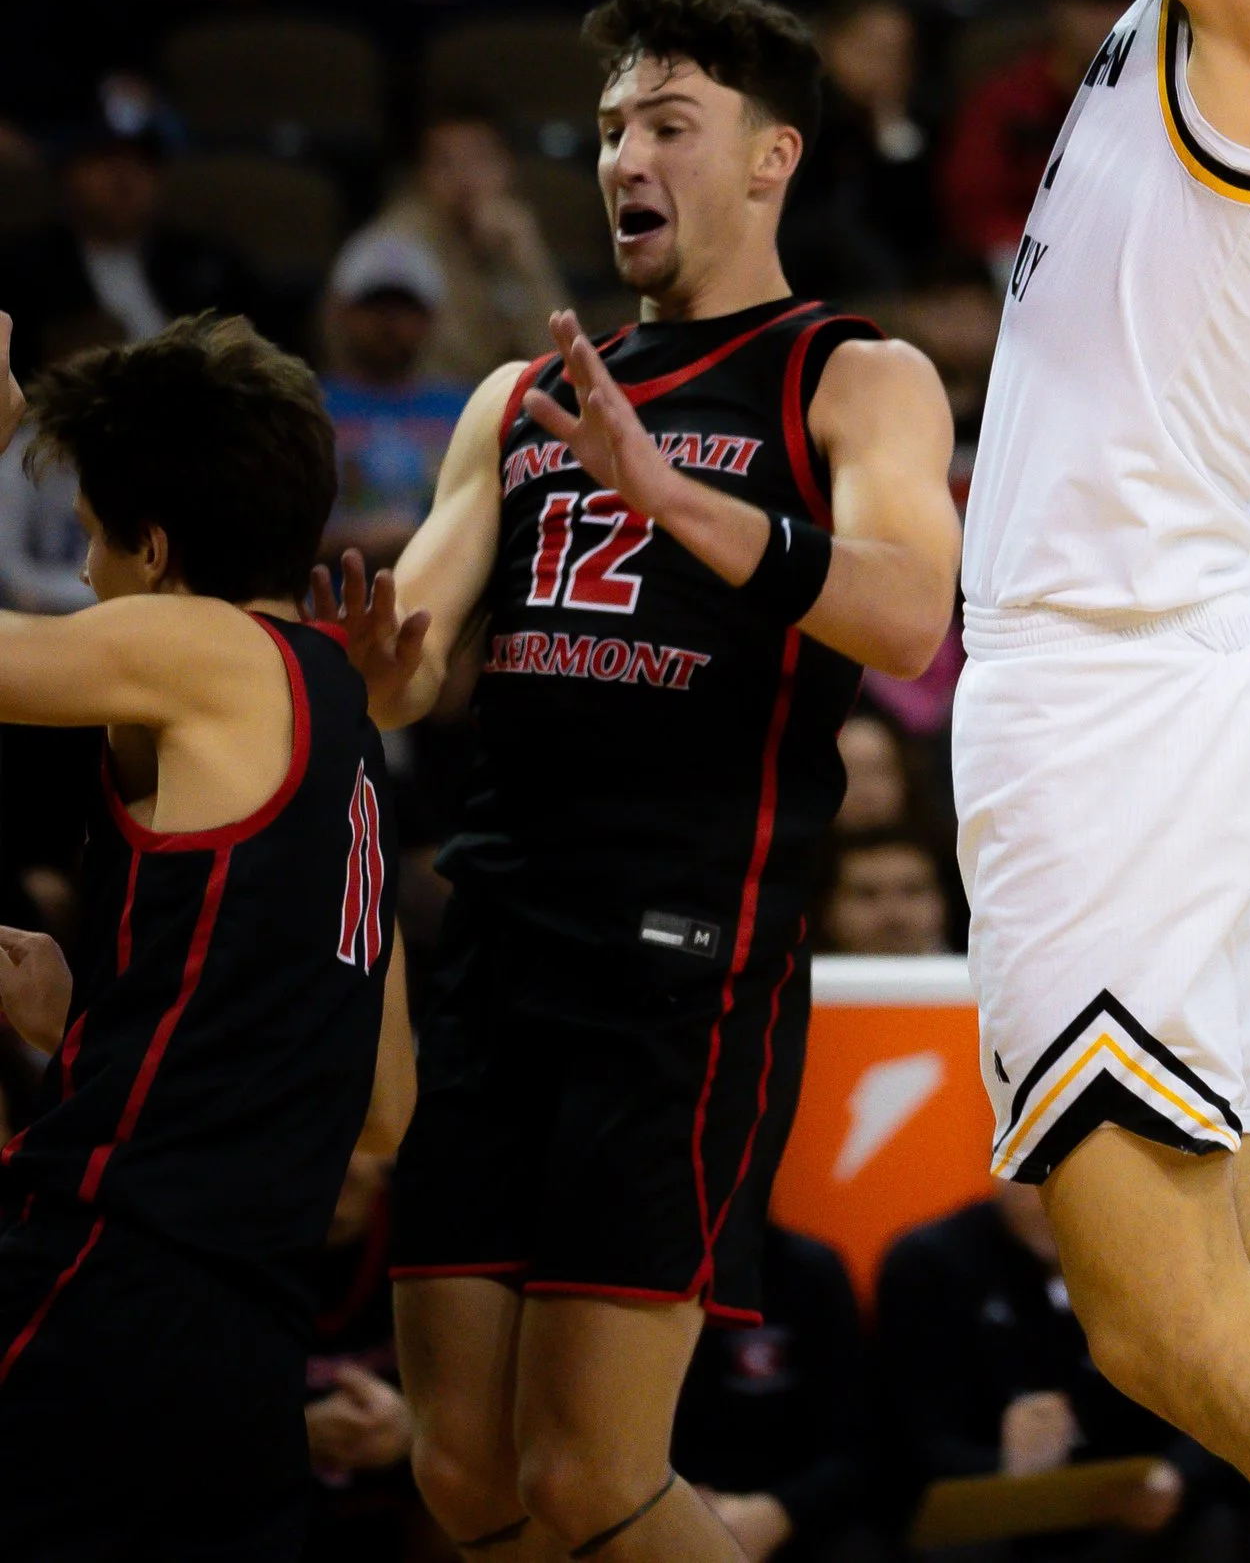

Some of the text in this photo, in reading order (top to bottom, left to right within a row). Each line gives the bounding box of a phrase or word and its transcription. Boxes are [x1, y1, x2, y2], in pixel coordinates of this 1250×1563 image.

[525, 489, 655, 616] 12
[482, 630, 712, 691] LERMONT
[336, 756, 385, 979] 11
[693, 929, 711, 947] M
